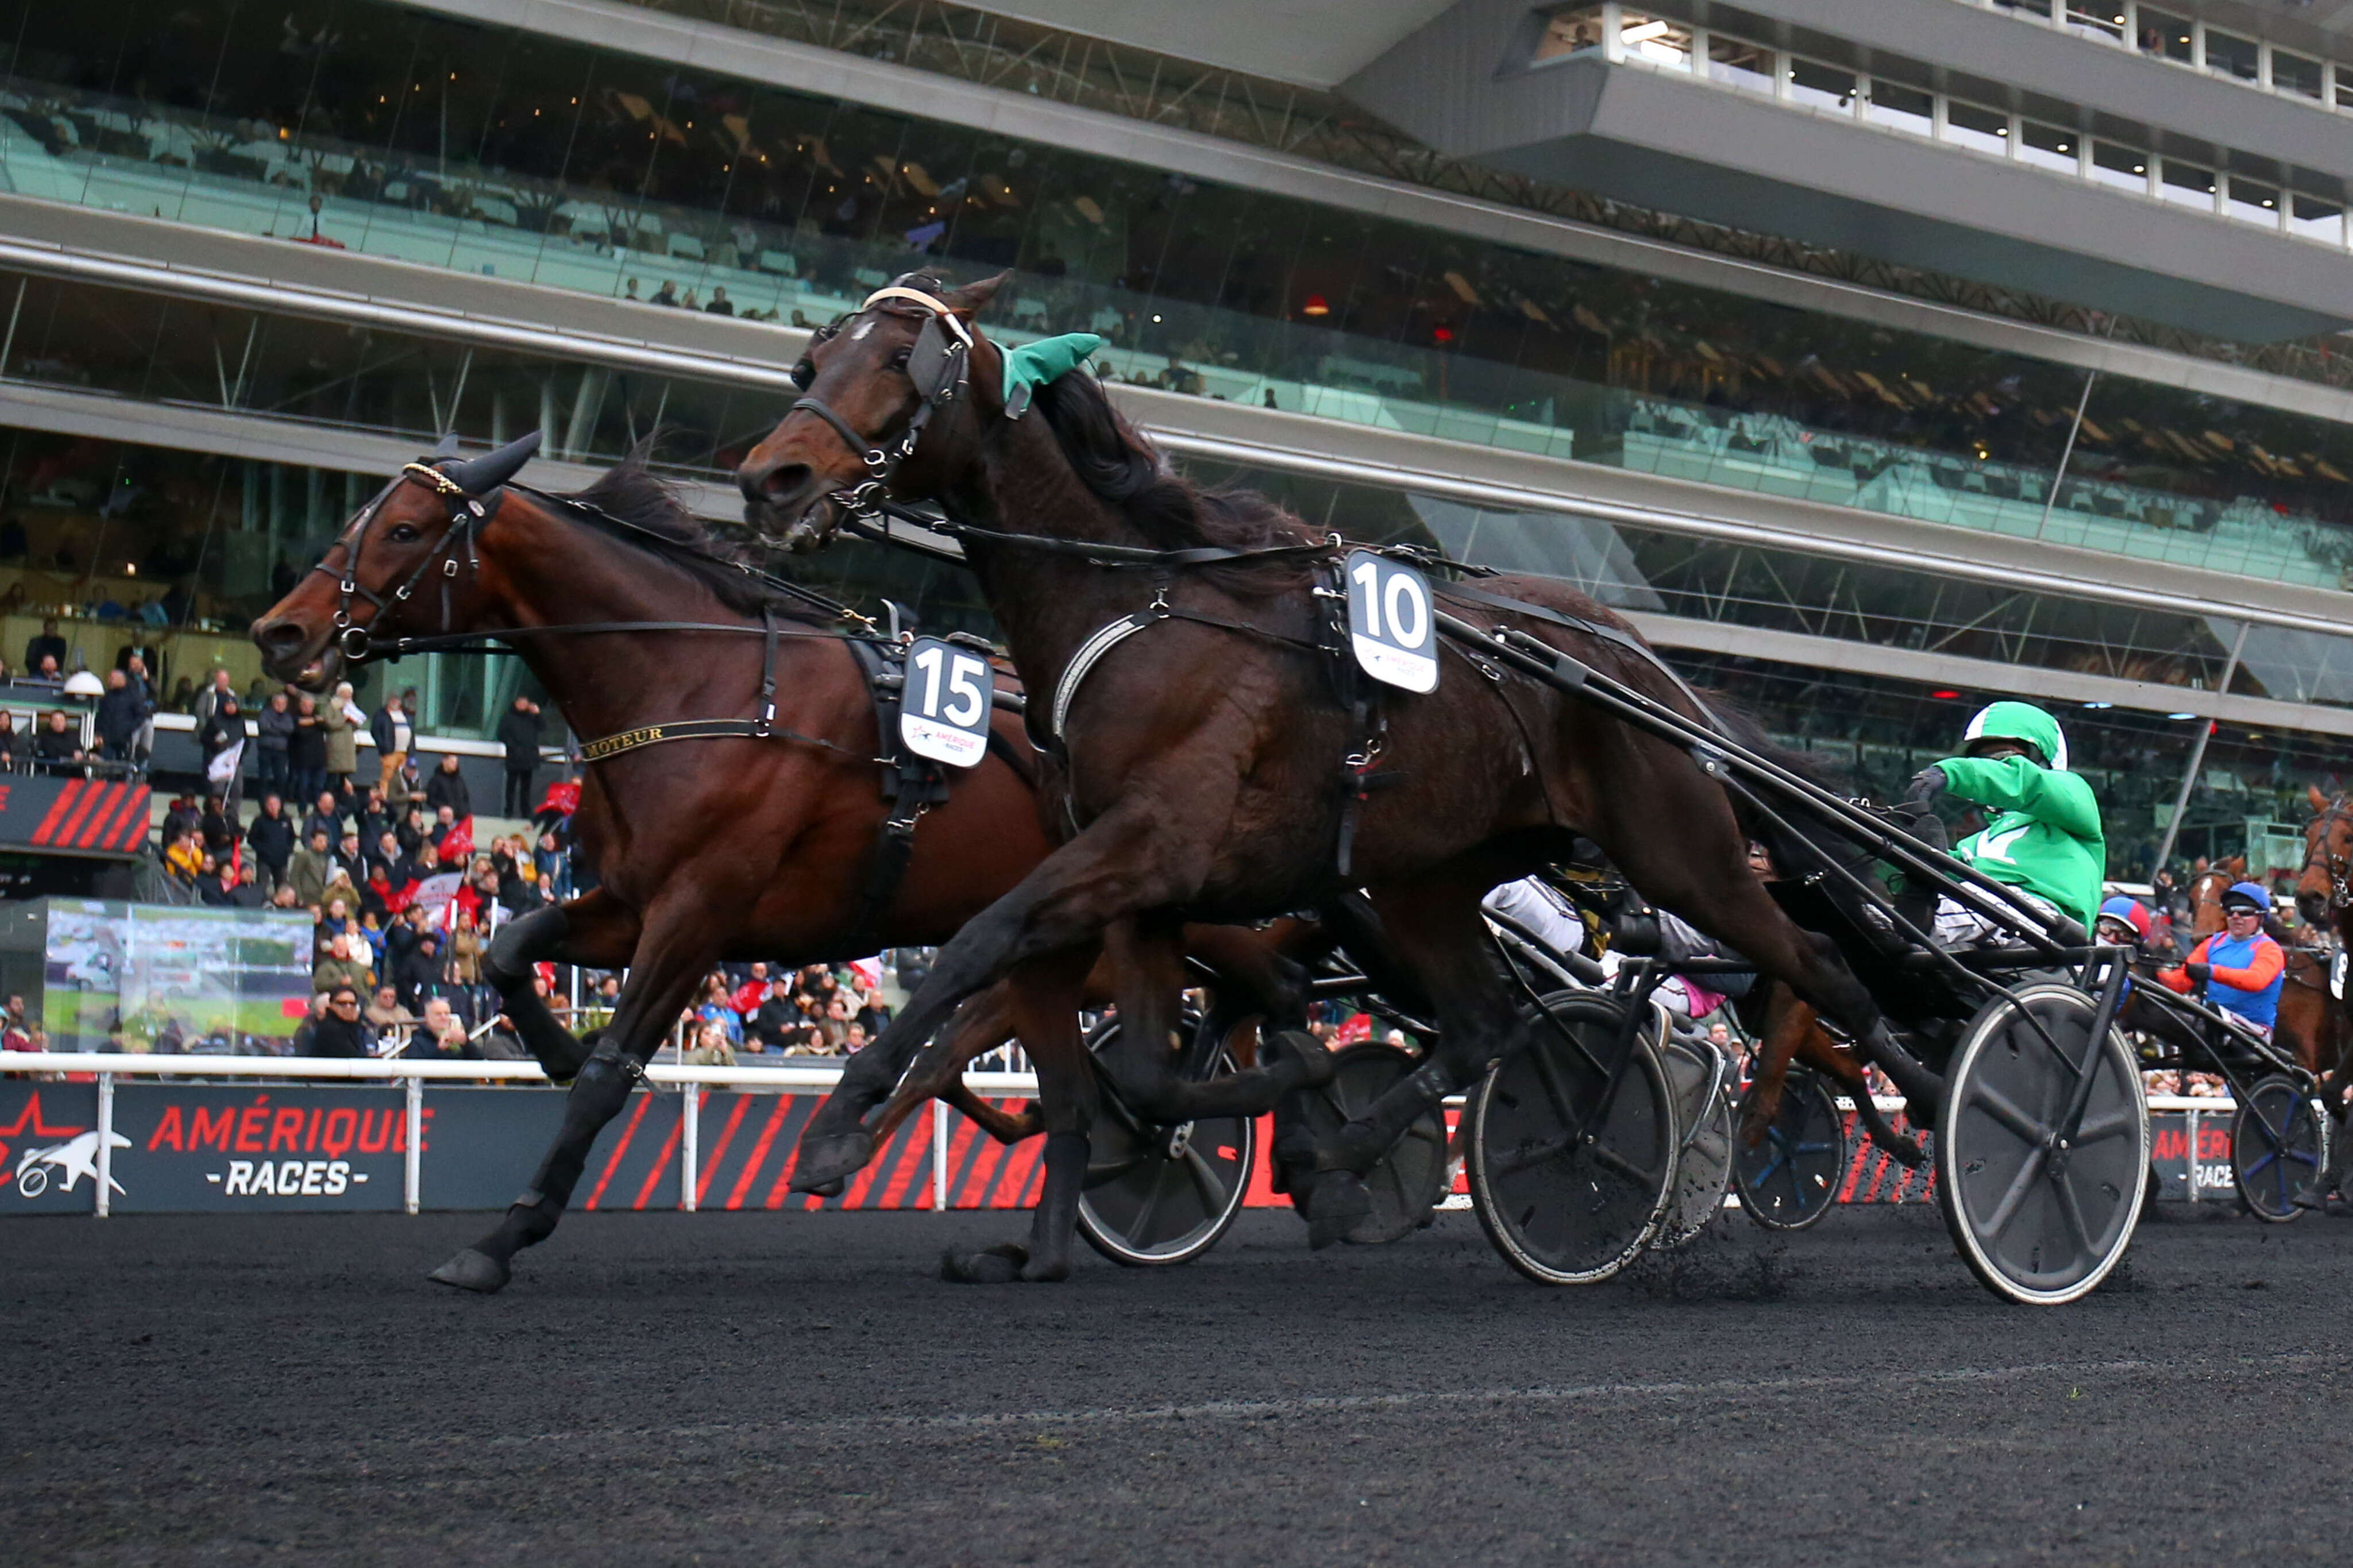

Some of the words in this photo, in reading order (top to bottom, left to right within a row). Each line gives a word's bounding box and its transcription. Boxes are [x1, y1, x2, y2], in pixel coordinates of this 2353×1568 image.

[1352, 561, 1428, 648] 10
[915, 647, 985, 727] 15
[587, 728, 662, 757] MOTEUR
[148, 1095, 435, 1159] AMÉRIQUE
